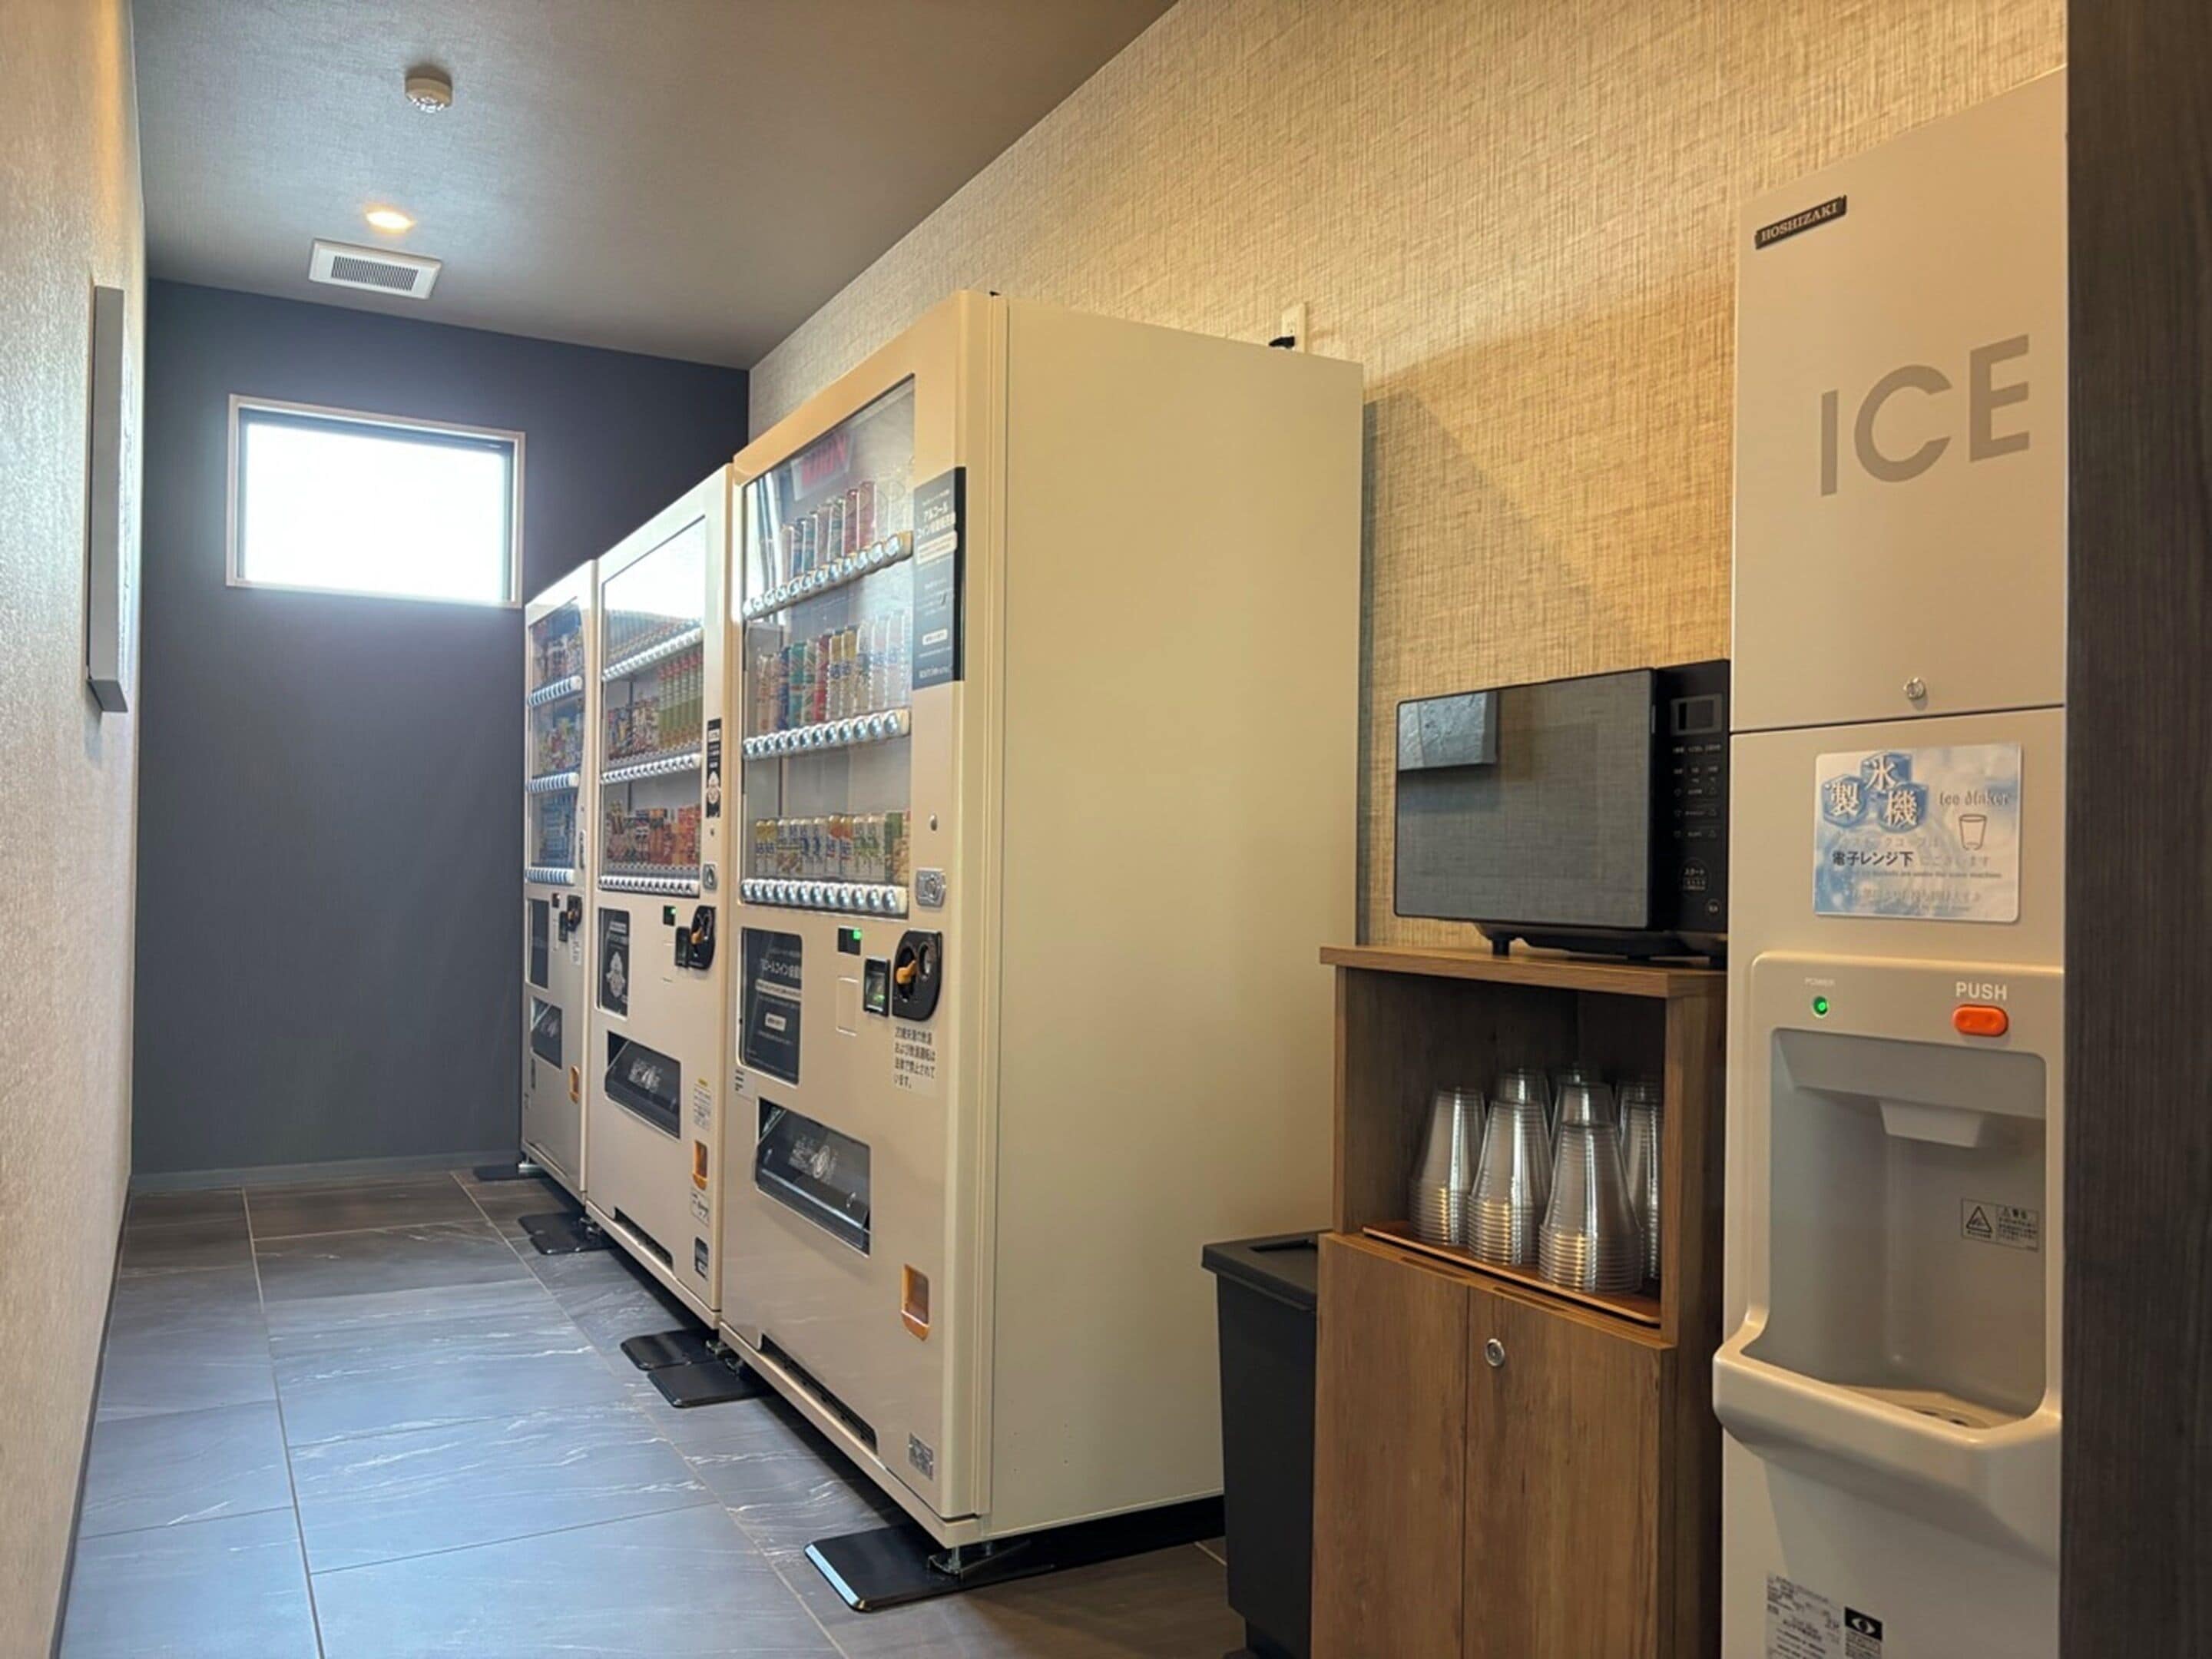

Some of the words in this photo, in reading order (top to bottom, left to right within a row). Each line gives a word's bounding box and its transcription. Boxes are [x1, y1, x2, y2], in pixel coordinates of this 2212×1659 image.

[1760, 201, 1839, 243] HOSHIZAKI
[1820, 333, 2030, 497] ICE
[1832, 850, 1914, 867] 電子レンジ下
[1955, 981, 2008, 1001] PUSH
